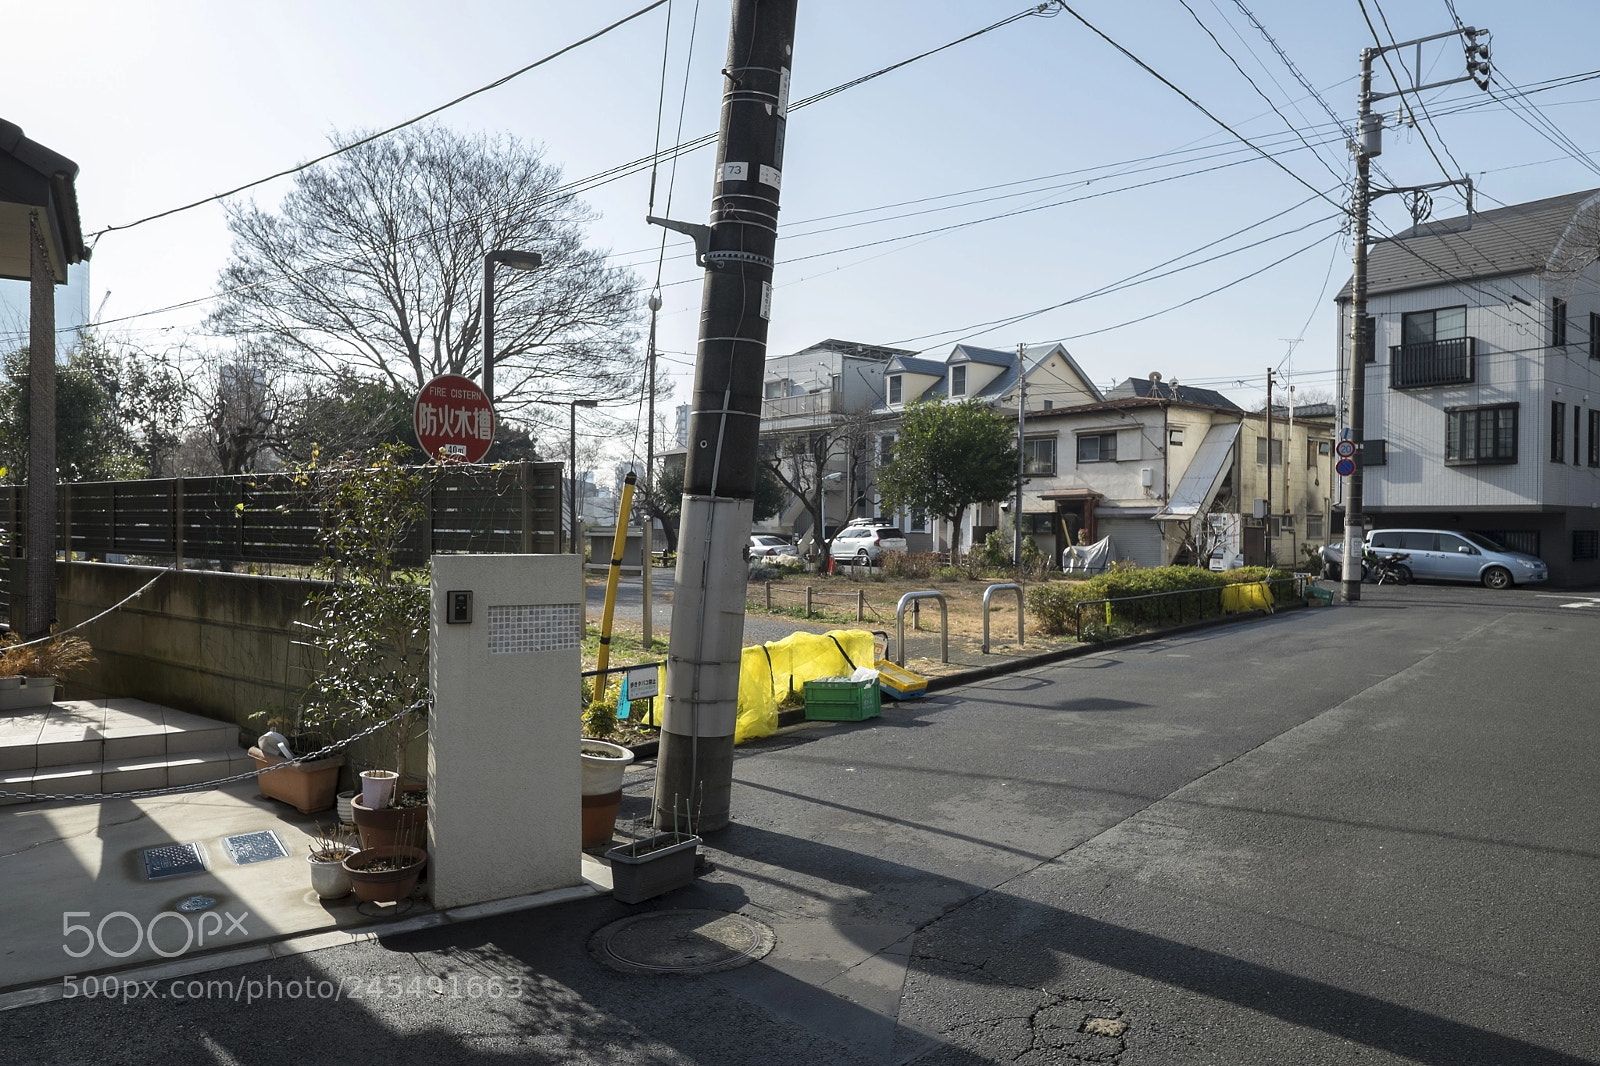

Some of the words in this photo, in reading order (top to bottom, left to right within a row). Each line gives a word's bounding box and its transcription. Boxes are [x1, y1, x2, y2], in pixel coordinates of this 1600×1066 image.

[728, 165, 742, 175] 73
[429, 386, 447, 397] FIRE
[450, 388, 482, 401] CISTERN
[1340, 444, 1351, 454] 20
